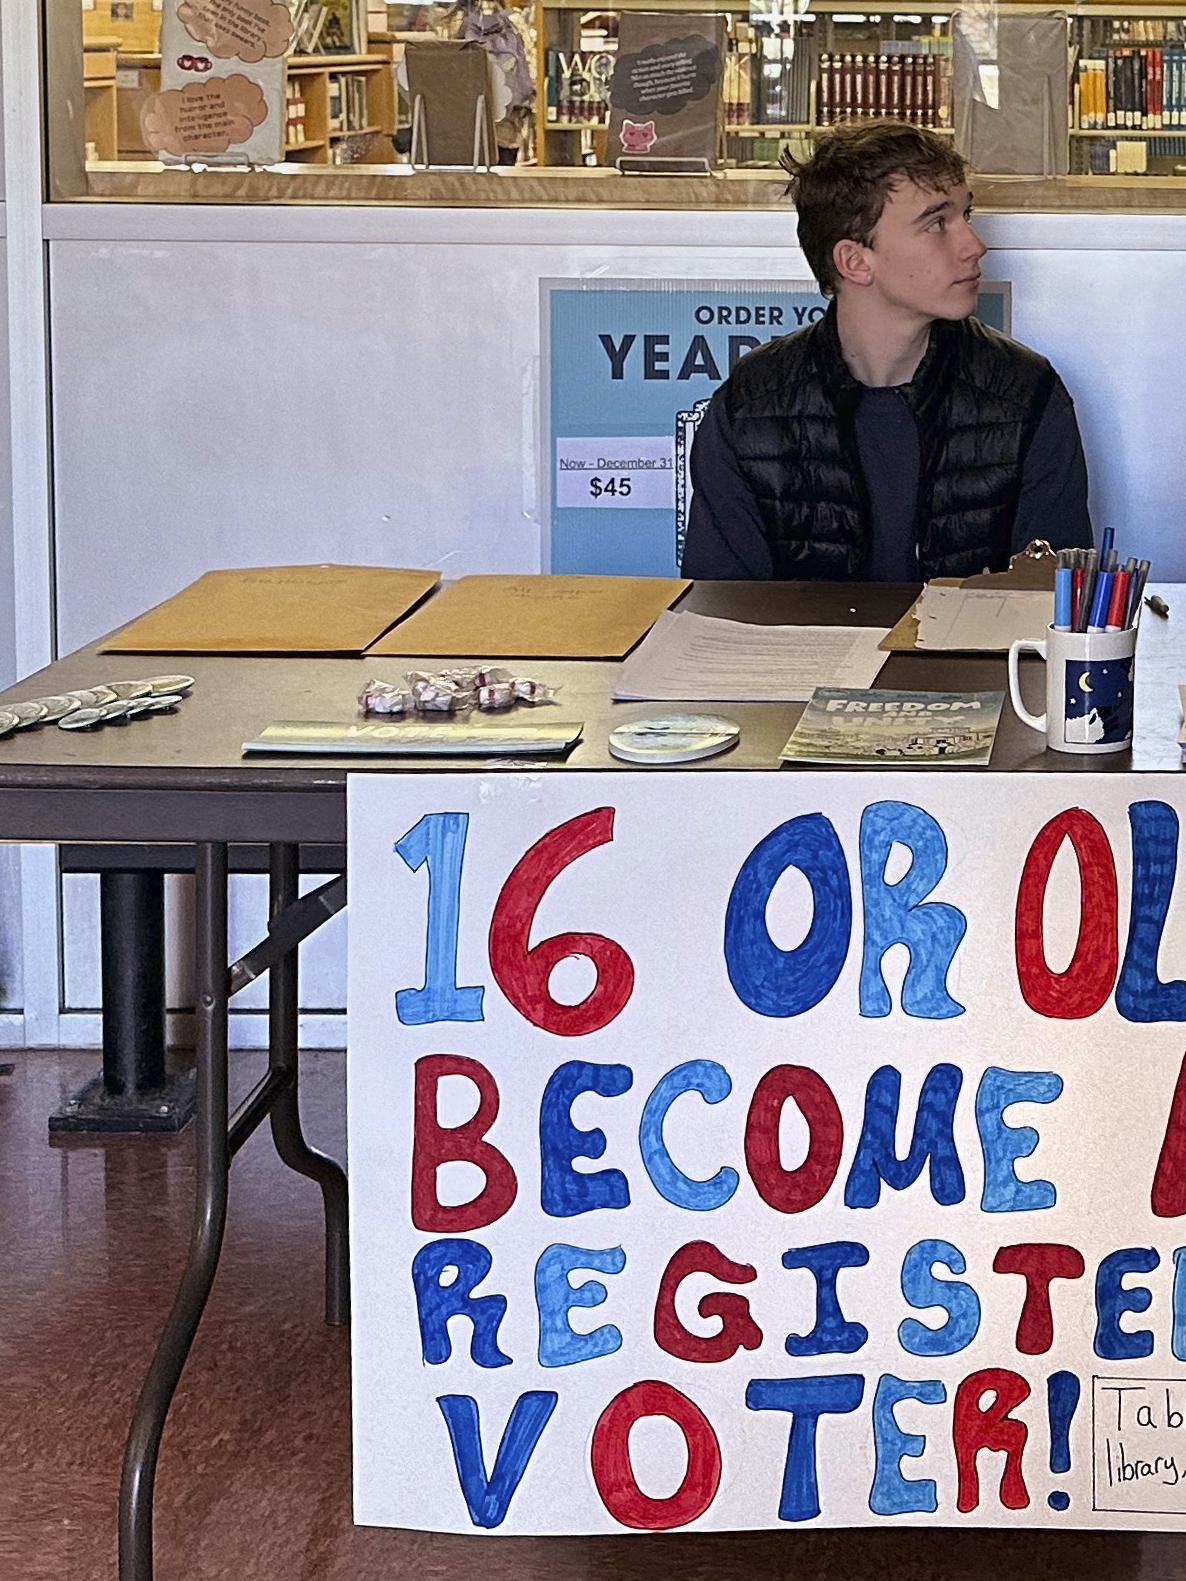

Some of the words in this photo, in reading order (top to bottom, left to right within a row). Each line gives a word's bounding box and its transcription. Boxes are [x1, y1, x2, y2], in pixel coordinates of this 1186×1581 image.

[187, 94, 204, 103] love
[206, 93, 221, 101] the
[209, 101, 226, 110] and
[174, 123, 196, 134] from
[197, 121, 213, 130] the
[215, 119, 235, 129] main
[694, 305, 785, 326] ORDER
[791, 306, 827, 326] YO
[559, 457, 585, 470] Now
[597, 456, 656, 470] December
[660, 456, 674, 470] 31
[589, 476, 632, 499] $45
[826, 700, 982, 713] FREEDOM
[831, 716, 966, 728] UNITY
[347, 726, 453, 739] VOTE
[394, 806, 635, 1037] 16
[723, 800, 967, 1019] OR
[410, 1053, 1064, 1233] BECOME
[436, 1367, 1081, 1531] VOTER!
